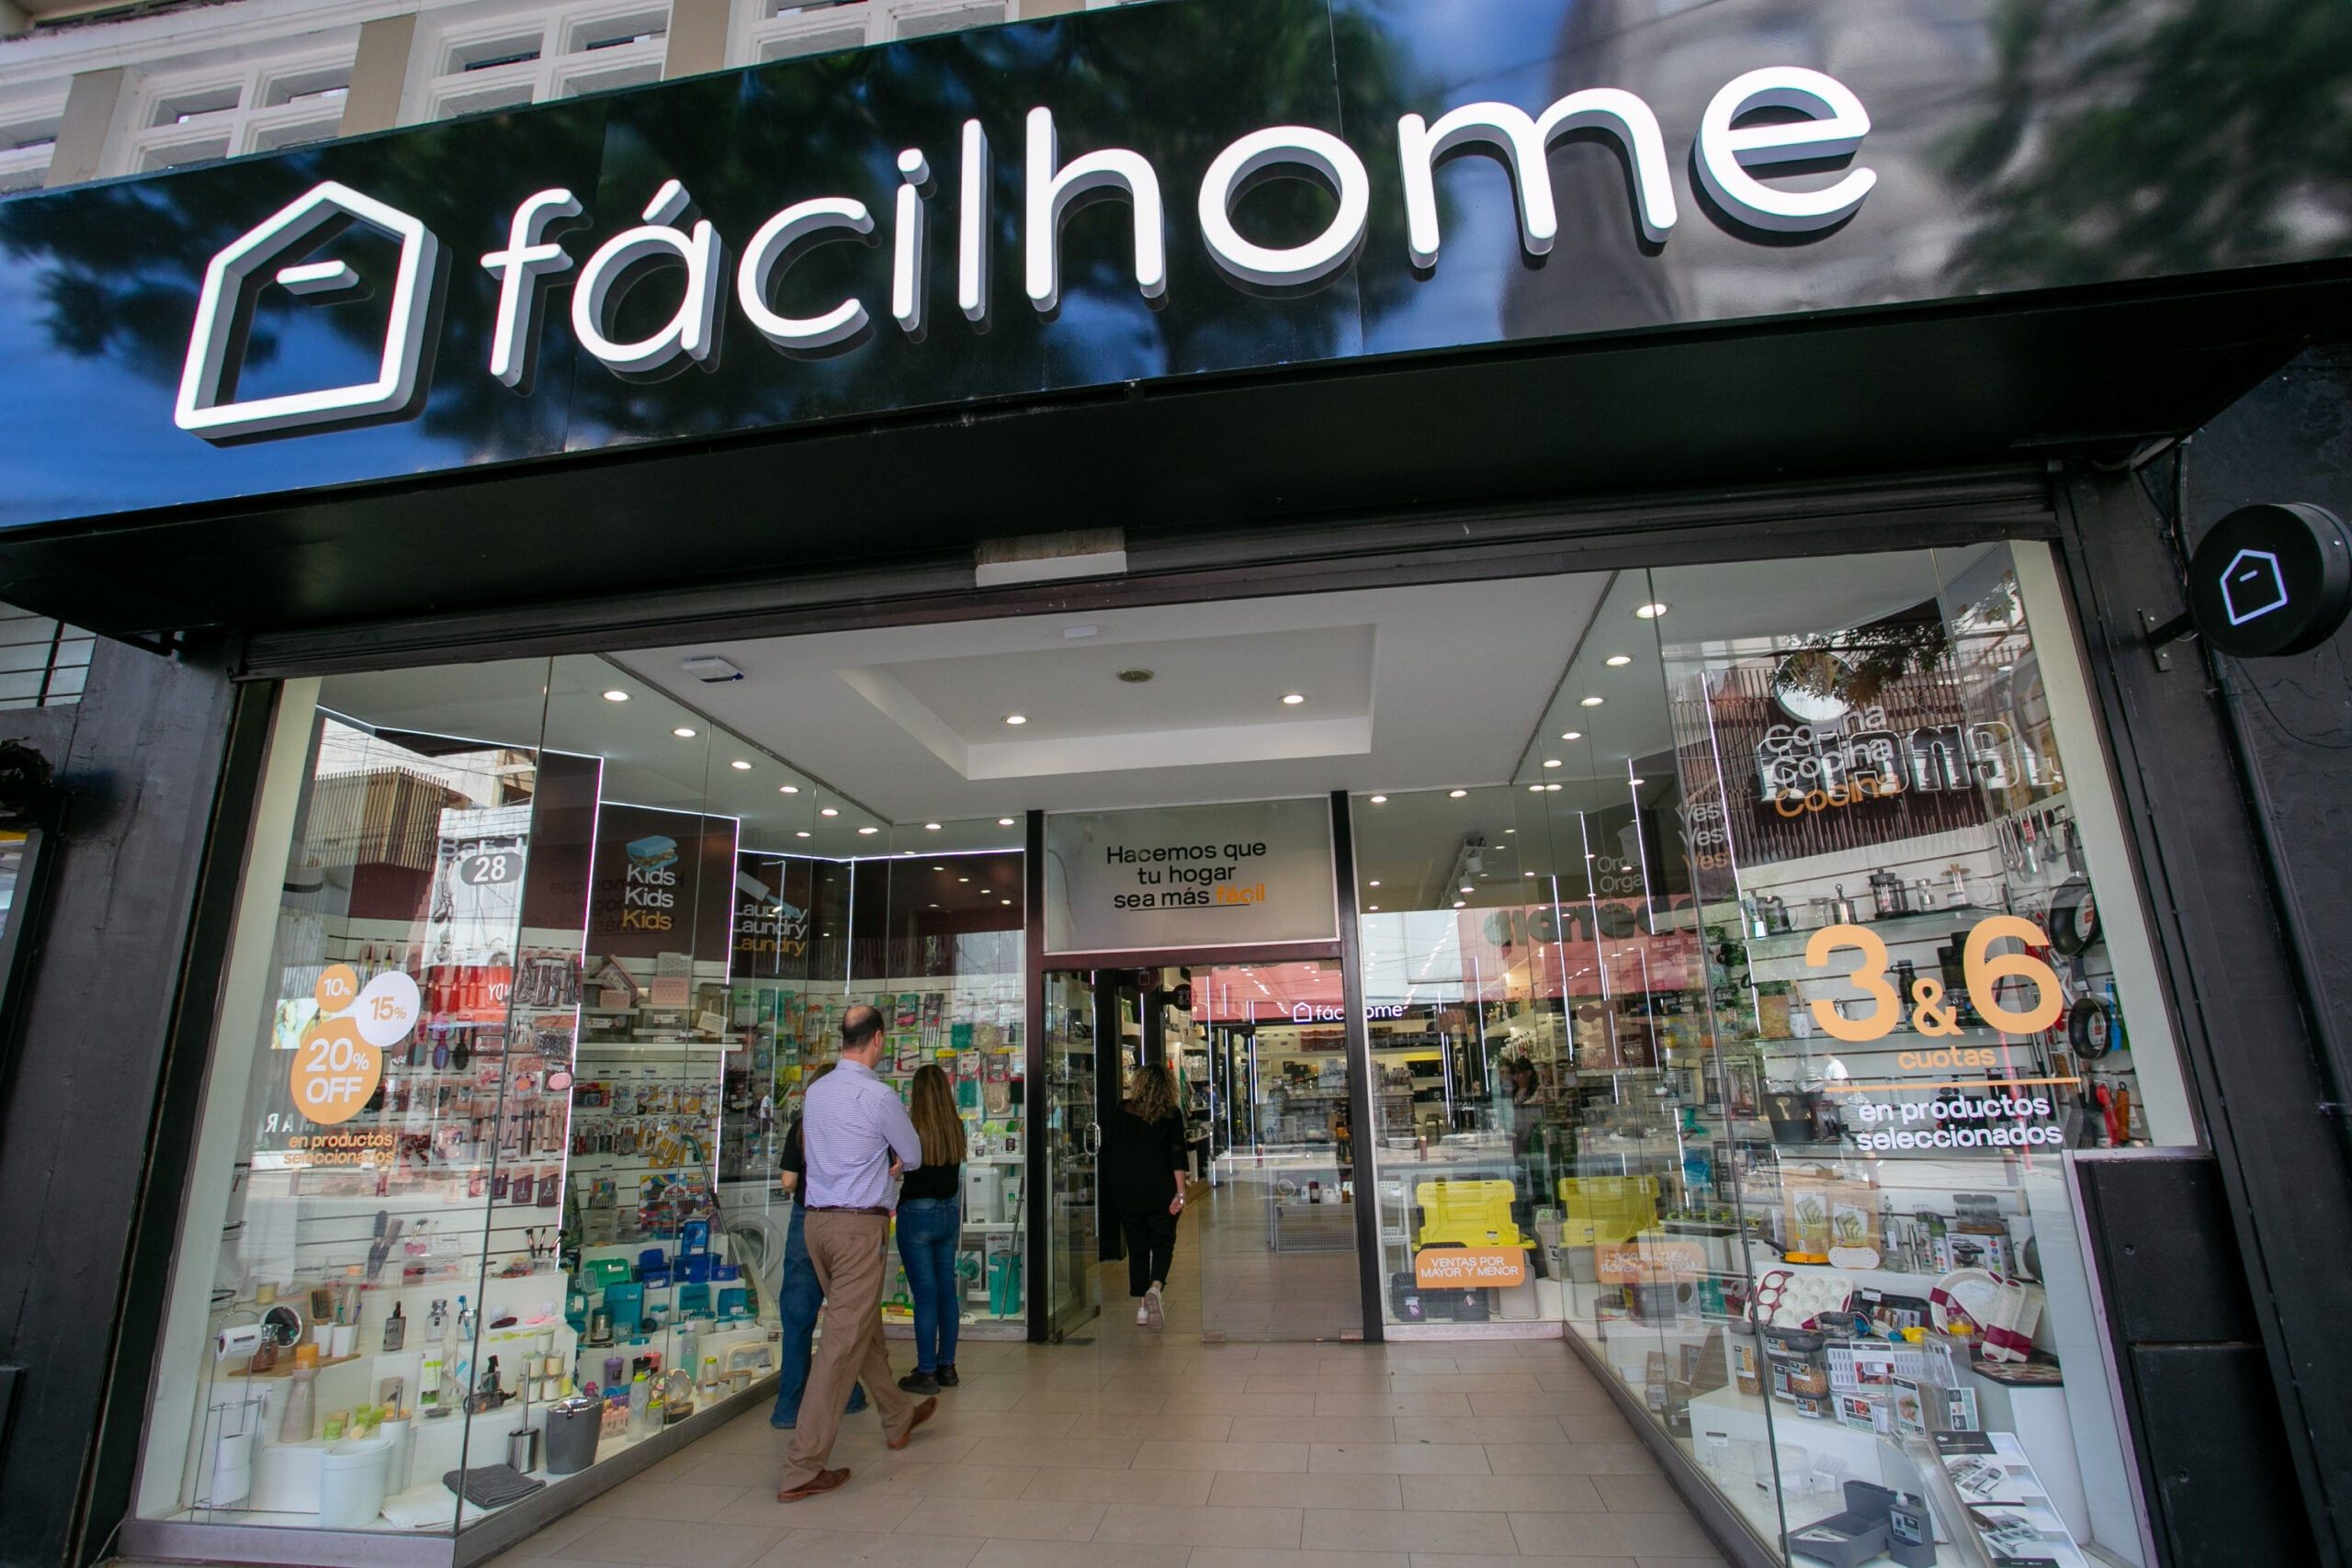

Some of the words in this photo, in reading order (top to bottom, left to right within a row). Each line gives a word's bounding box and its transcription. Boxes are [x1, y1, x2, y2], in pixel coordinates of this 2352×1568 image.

[480, 64, 1879, 386] fácilhome
[1770, 739, 1894, 784] Cocina
[1774, 773, 1900, 817] Cocina
[1106, 843, 1217, 864] Hacemos
[1223, 840, 1267, 862] que
[473, 855, 507, 882] 28
[627, 863, 676, 886] Kids
[1136, 866, 1161, 885] tu
[1169, 864, 1237, 886] hogar
[625, 886, 674, 908] Kids
[1114, 893, 1156, 909] sea
[1160, 886, 1210, 907] más
[1216, 882, 1265, 905] fácil
[622, 908, 673, 931] Kids
[323, 977, 353, 997] 10%
[1805, 924, 1900, 1042] 3
[1911, 976, 1965, 1037] &
[1963, 915, 2064, 1034] 6
[369, 995, 407, 1021] 15%
[305, 1037, 369, 1073] 20%
[1897, 1045, 1996, 1071] cuotas
[305, 1076, 364, 1104] OFF
[1858, 1102, 1891, 1122] en
[1901, 1093, 2051, 1125] productos
[288, 1134, 308, 1148] en
[311, 1131, 395, 1150] productos
[1855, 1122, 2064, 1150] seleccionados
[282, 1148, 397, 1166] seleccionados
[1420, 1268, 1463, 1278] MAYOR
[1464, 1268, 1474, 1277] Y
[1476, 1265, 1520, 1277] MENOR
[1430, 1257, 1477, 1268] VENTAS
[1478, 1256, 1505, 1267] POR
